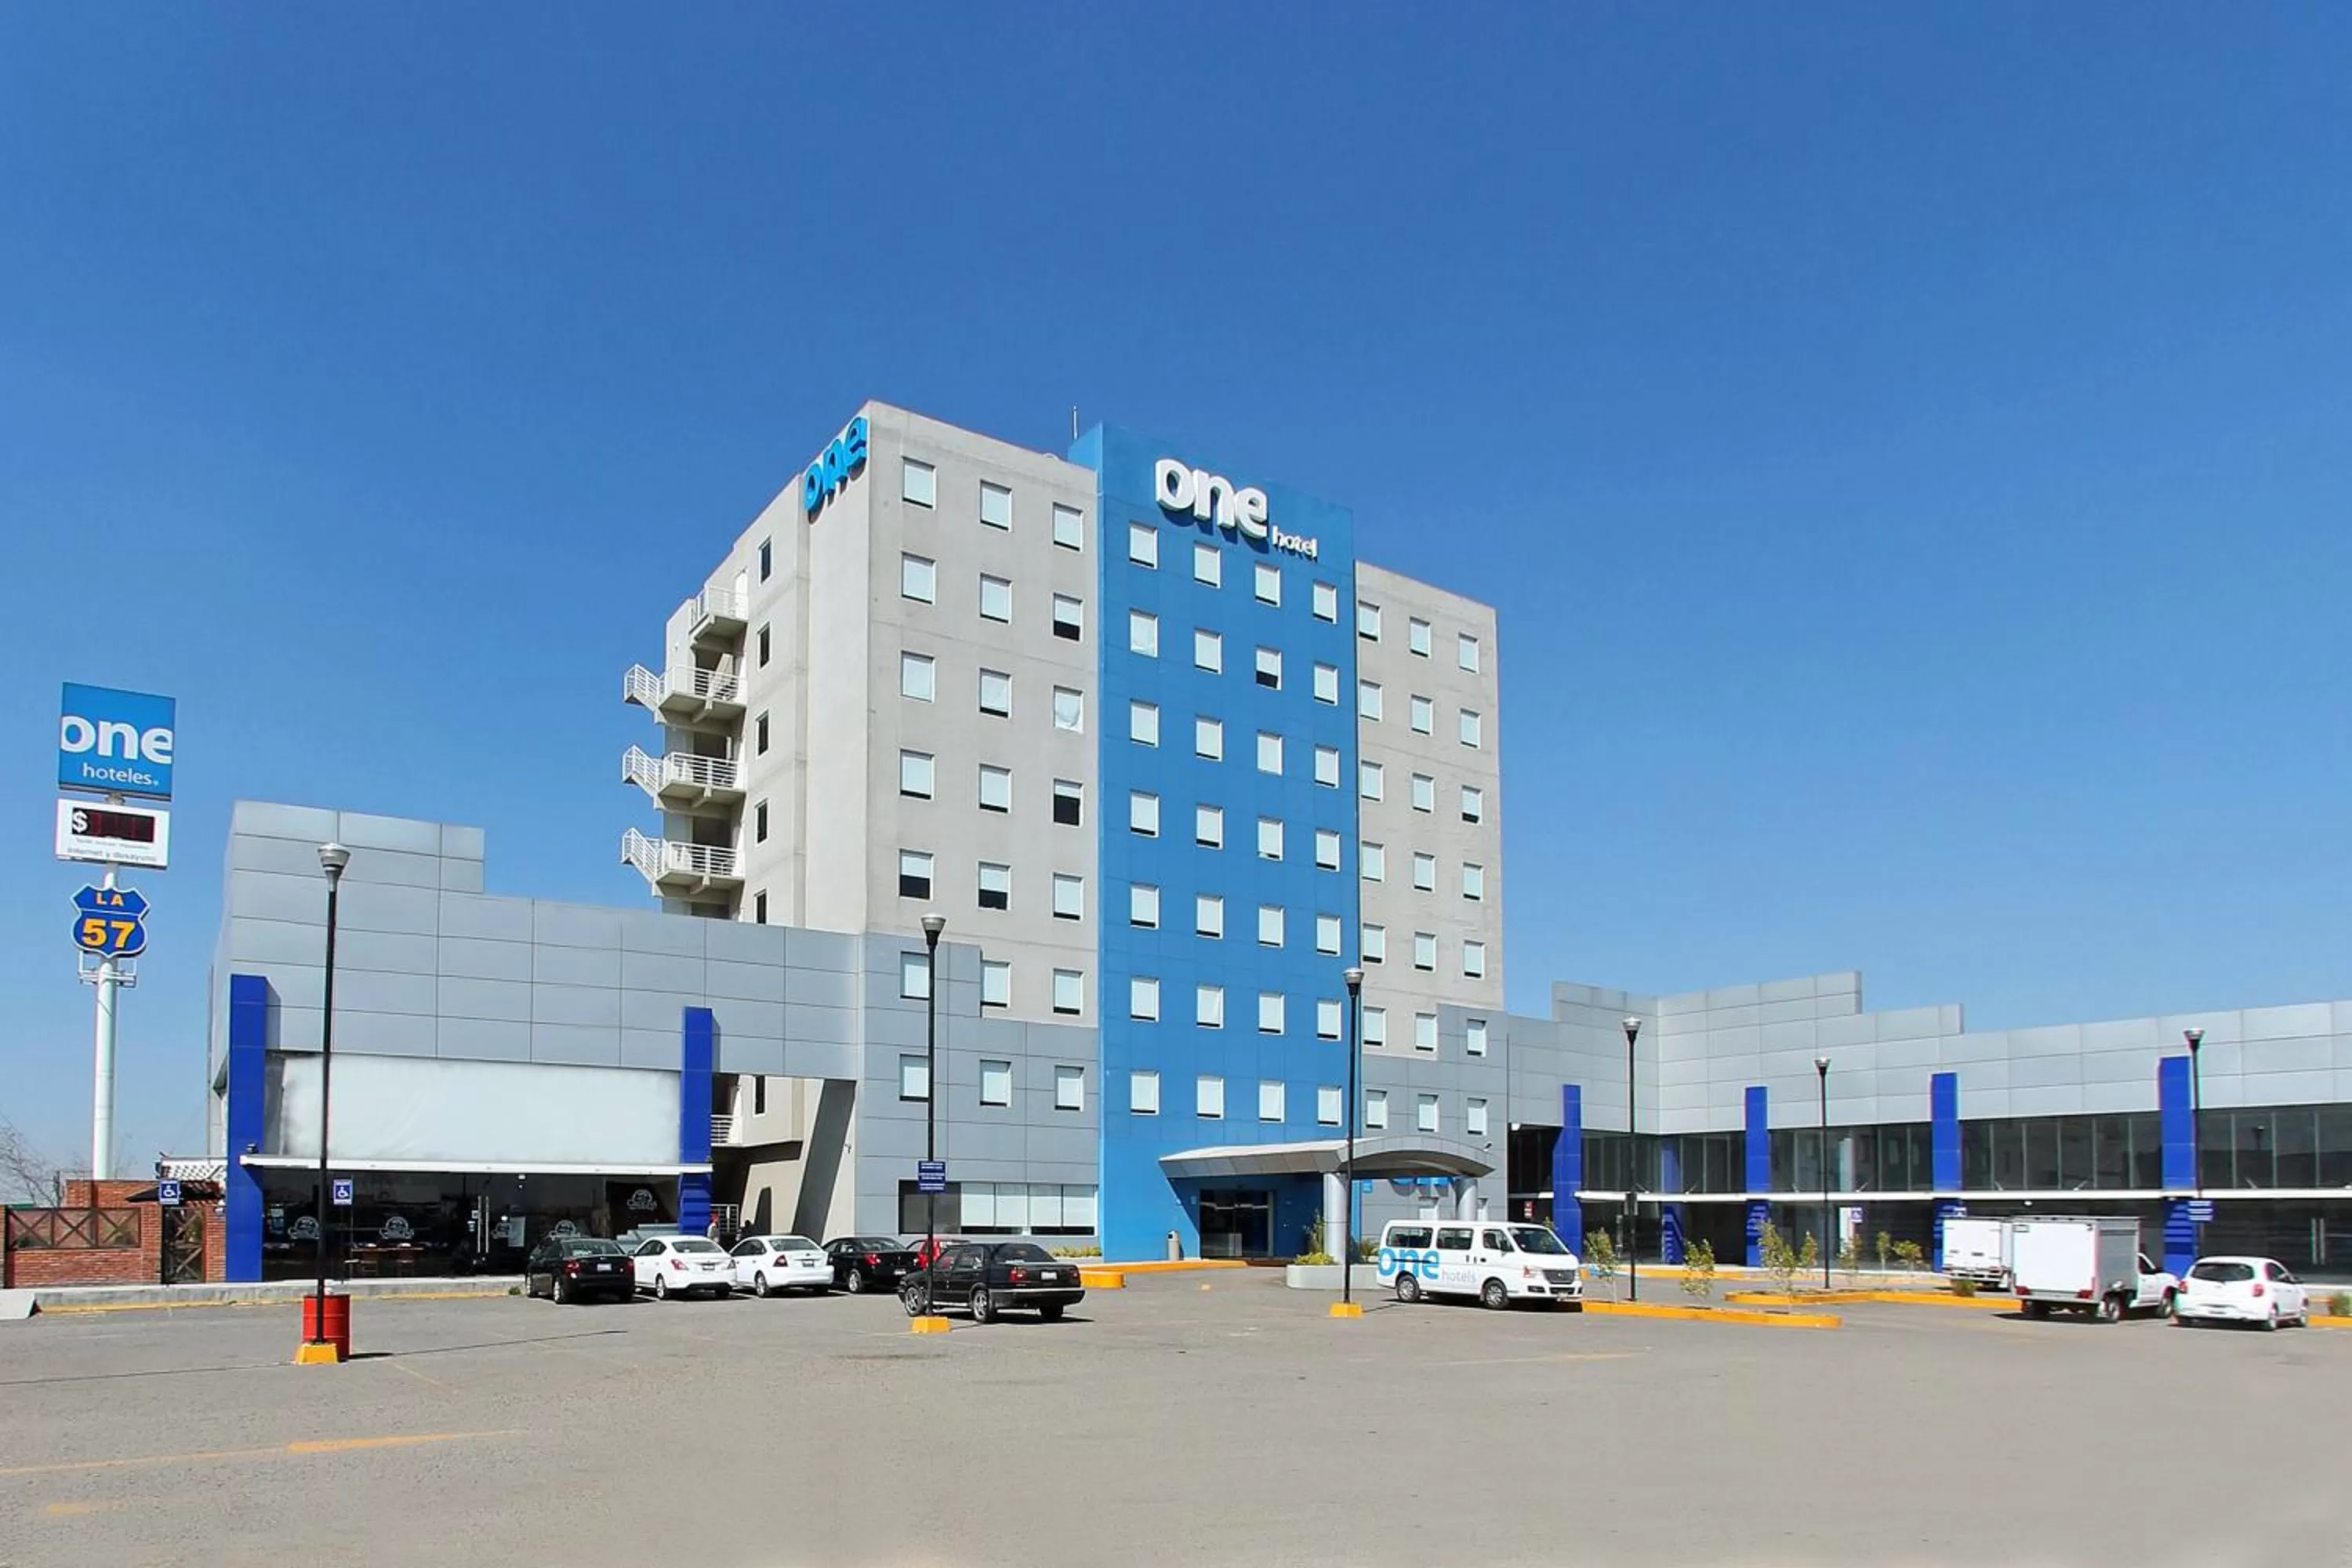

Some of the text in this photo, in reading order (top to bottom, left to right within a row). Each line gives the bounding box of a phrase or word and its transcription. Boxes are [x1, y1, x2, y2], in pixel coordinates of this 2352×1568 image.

[804, 416, 866, 510] one
[1156, 459, 1268, 538] one
[1272, 524, 1317, 558] hotel
[61, 715, 173, 764] one
[72, 811, 89, 833] $
[96, 891, 125, 906] LA
[82, 918, 136, 948] 57
[1378, 1247, 1439, 1279] one
